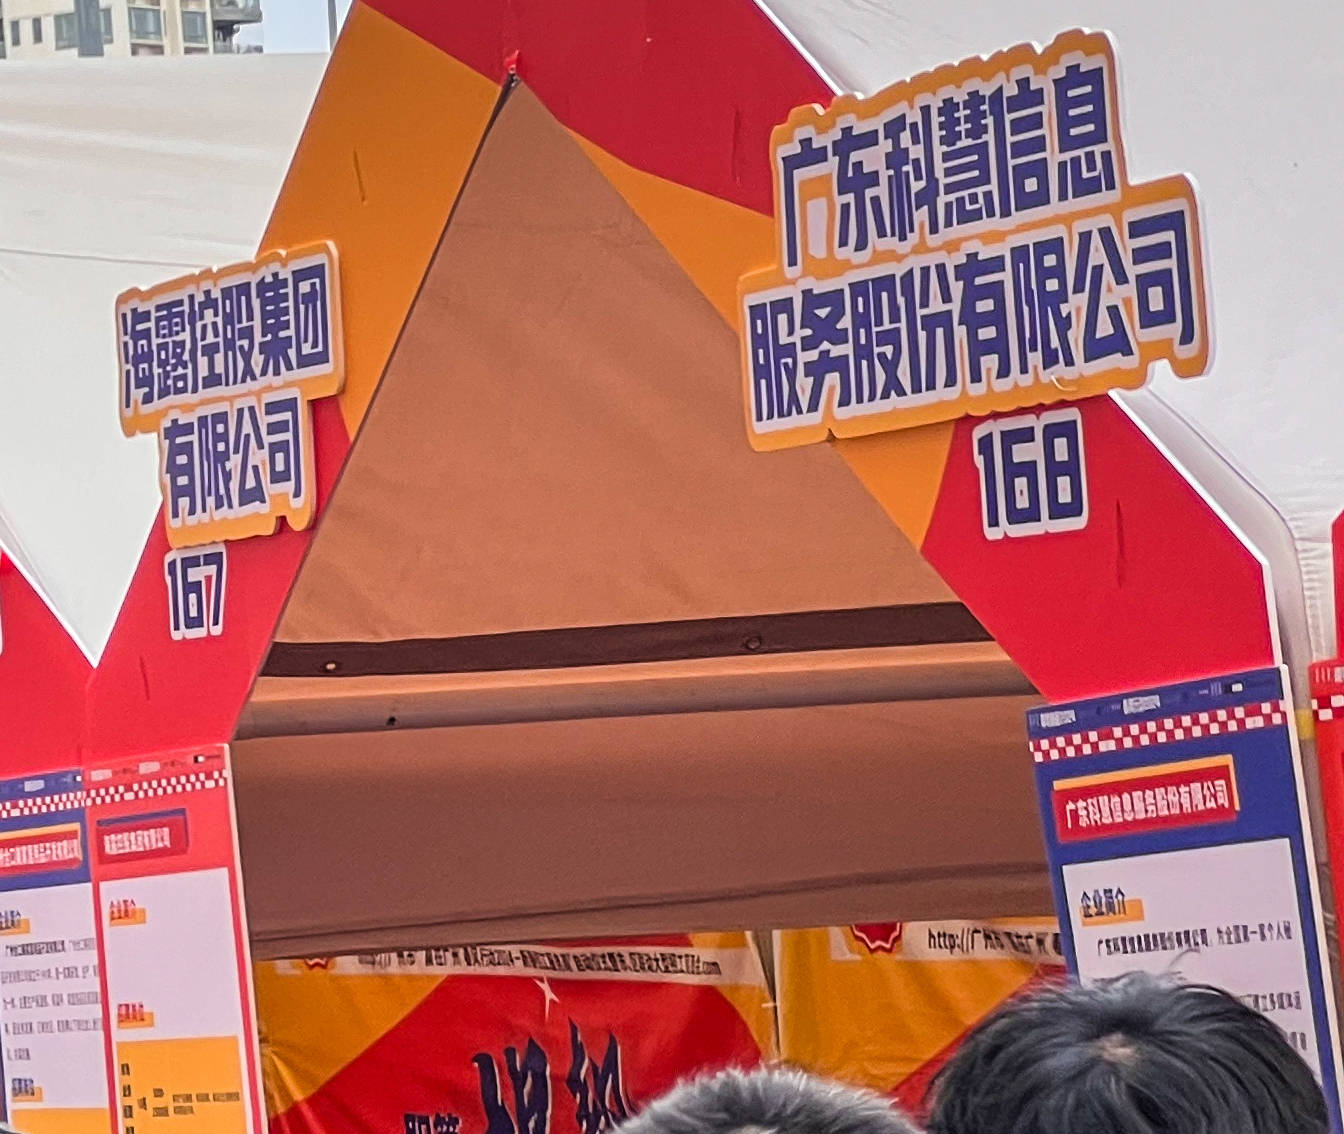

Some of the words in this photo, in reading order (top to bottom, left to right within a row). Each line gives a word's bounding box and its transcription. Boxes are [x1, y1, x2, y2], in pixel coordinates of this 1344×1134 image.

[781, 63, 1116, 268] 广东科慧信息
[121, 262, 330, 417] 海露控股集团
[749, 210, 1194, 422] 服务股份有限公司
[163, 400, 302, 520] 有限公司
[978, 419, 1086, 529] 168
[168, 551, 224, 634] 167
